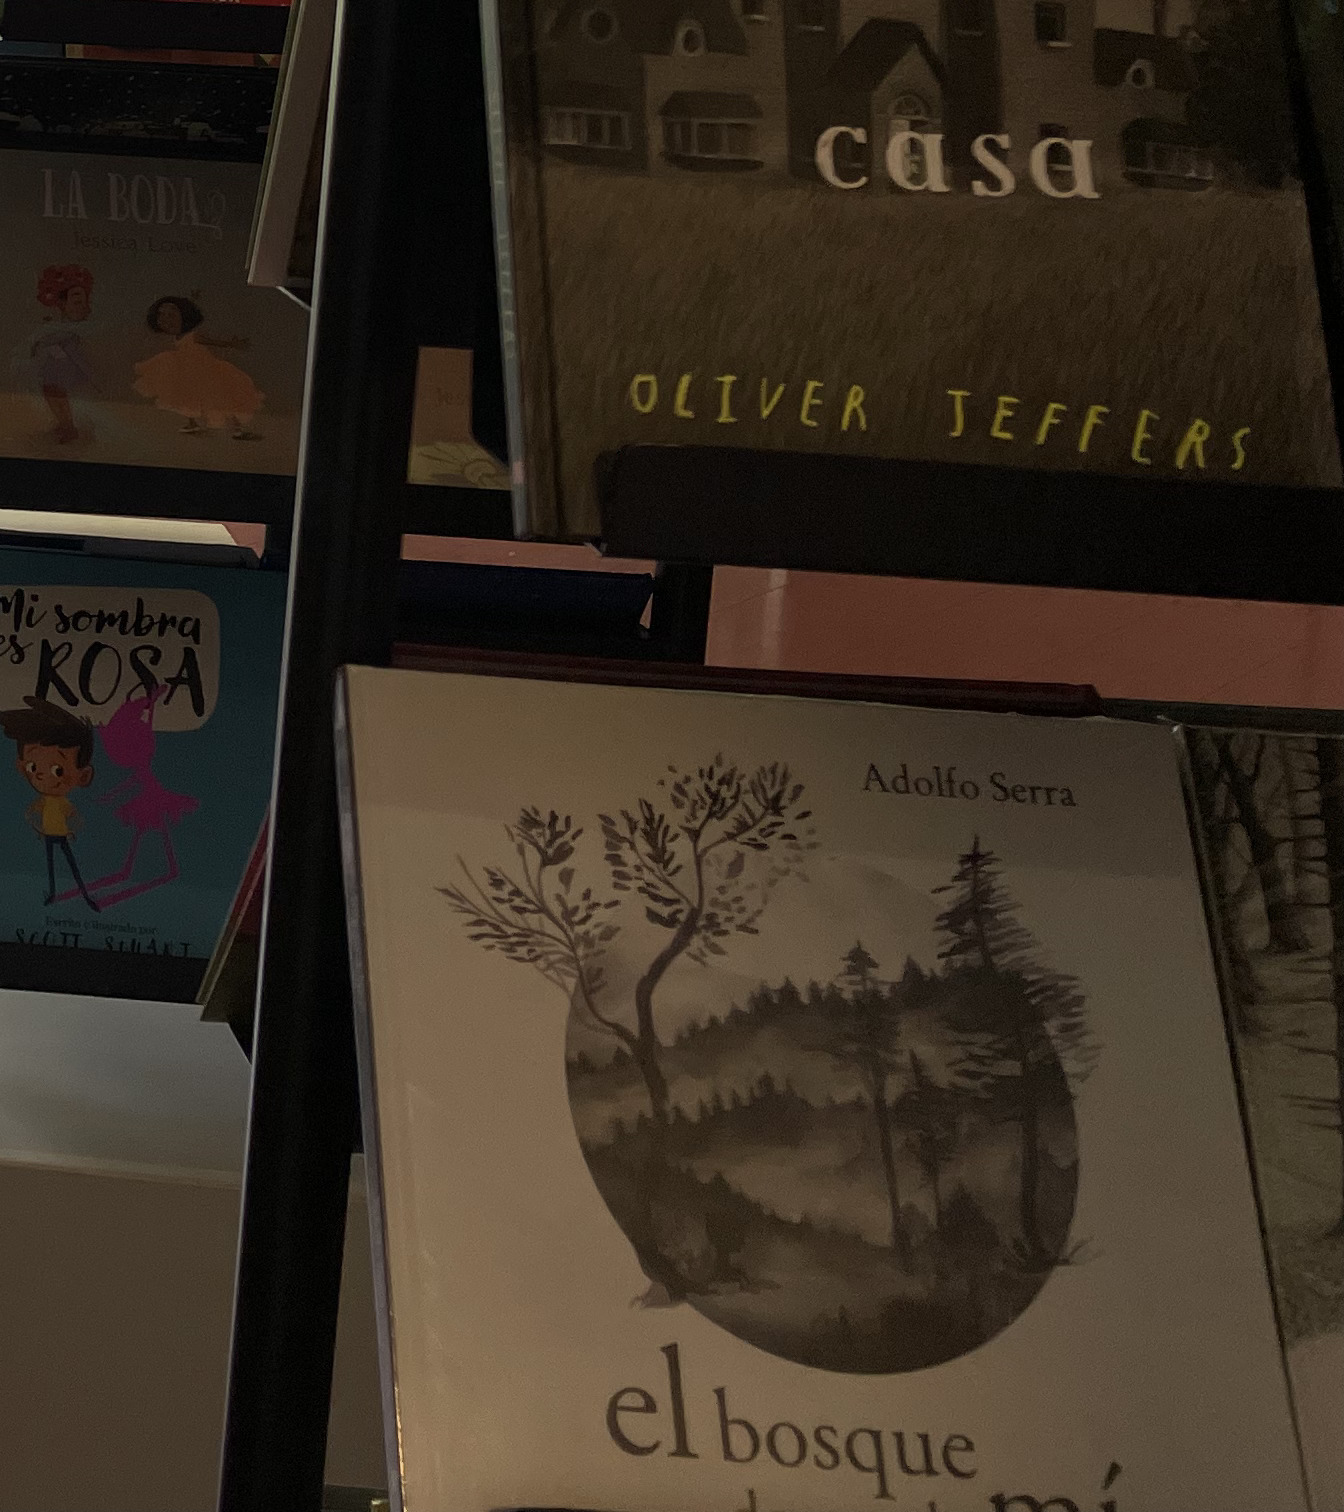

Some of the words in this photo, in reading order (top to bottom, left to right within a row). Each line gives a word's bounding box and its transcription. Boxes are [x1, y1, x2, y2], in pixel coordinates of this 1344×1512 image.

[41, 168, 88, 220] LA
[107, 172, 216, 229] BODA
[815, 121, 1105, 200] casa
[627, 373, 870, 433] OLIVER
[946, 387, 1253, 474] JEFFERS
[54, 597, 200, 645] sombra
[35, 638, 205, 718] ROSA
[863, 761, 980, 804] Adolfo
[993, 770, 1077, 810] Serra
[605, 1342, 700, 1460] el
[713, 1386, 978, 1501] bosque
